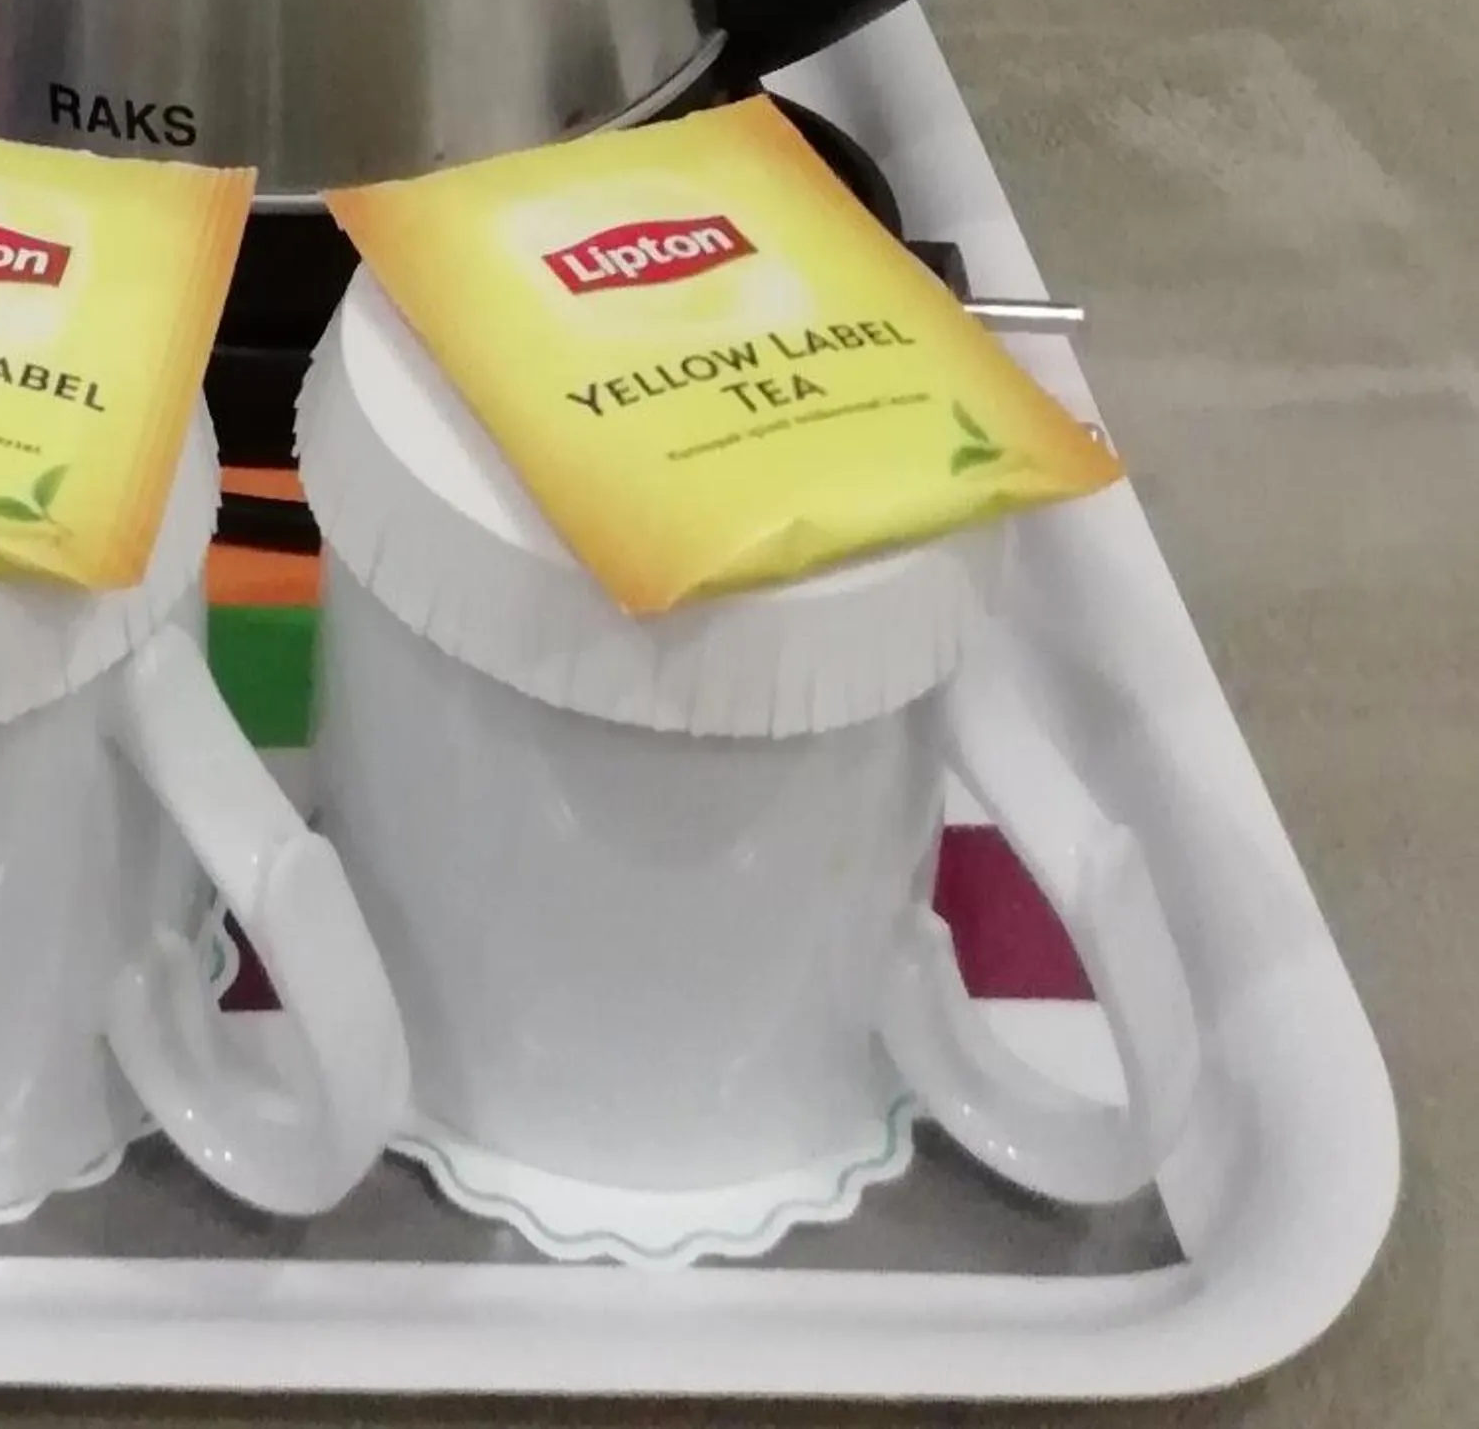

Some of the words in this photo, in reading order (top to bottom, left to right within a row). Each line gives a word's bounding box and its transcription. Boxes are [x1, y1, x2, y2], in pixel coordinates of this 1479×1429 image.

[49, 82, 197, 147] RAKS
[561, 226, 735, 283] Lipton
[565, 341, 760, 417] YELLOW
[767, 319, 916, 360] LABEL
[719, 373, 830, 414] TEA
